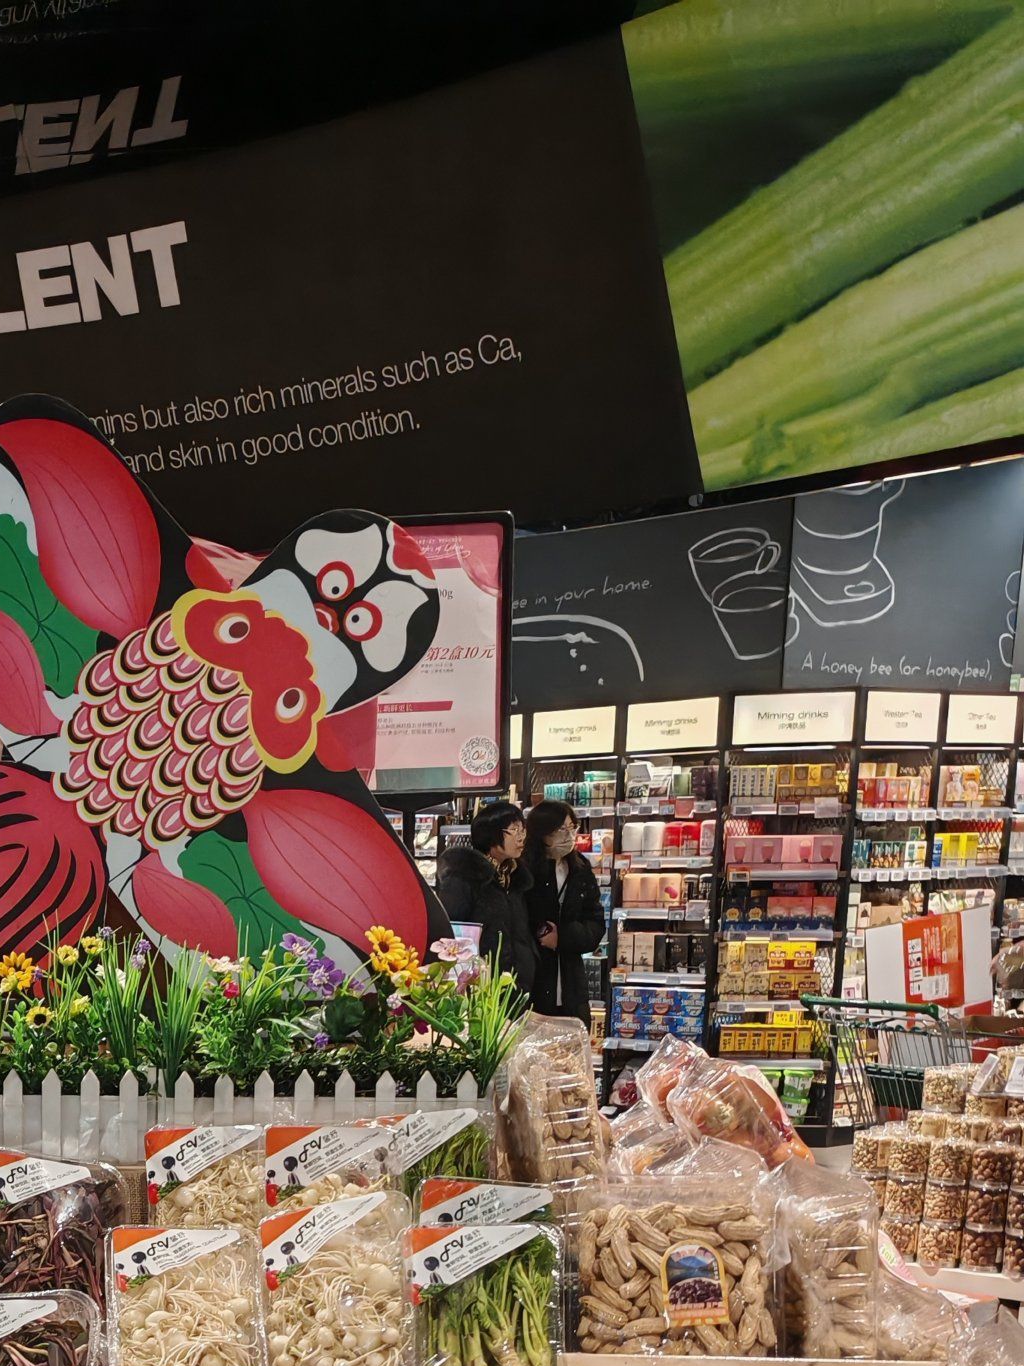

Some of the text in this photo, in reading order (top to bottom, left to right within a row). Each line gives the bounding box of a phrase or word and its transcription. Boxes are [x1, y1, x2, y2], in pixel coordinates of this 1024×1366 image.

[88, 410, 138, 436] mins
[141, 400, 180, 430] but
[184, 395, 229, 424] also
[234, 385, 276, 415] rich
[279, 367, 377, 408] minerals
[381, 351, 440, 387] such
[445, 346, 474, 374] as
[477, 333, 523, 365] Ca,
[123, 445, 164, 473] and
[168, 439, 213, 470] skin
[216, 437, 238, 462] in
[241, 424, 305, 464] good
[308, 405, 422, 447] condition.
[554, 588, 595, 612] your
[801, 651, 813, 671] A
[820, 652, 863, 683] honey
[870, 656, 892, 675] bee
